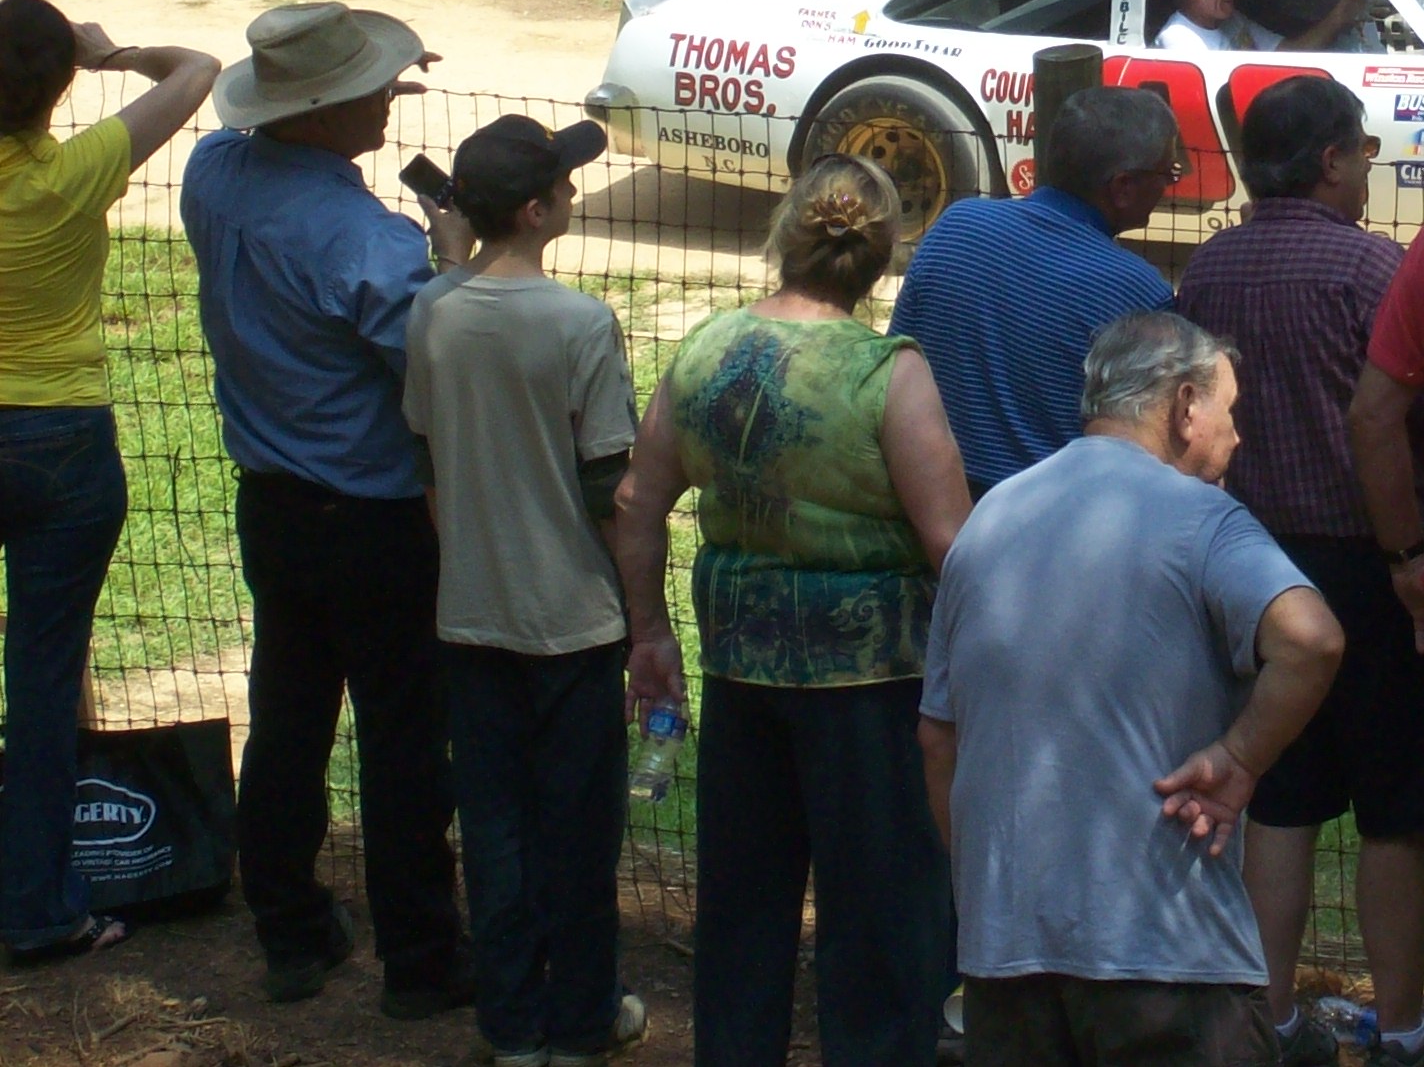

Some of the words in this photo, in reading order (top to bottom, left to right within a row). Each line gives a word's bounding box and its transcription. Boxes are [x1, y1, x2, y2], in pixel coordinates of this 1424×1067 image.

[669, 33, 797, 79] THOMAS
[864, 38, 963, 57] GOODYEAR
[674, 71, 777, 117] BROS.
[658, 127, 769, 158] ASHEBORO
